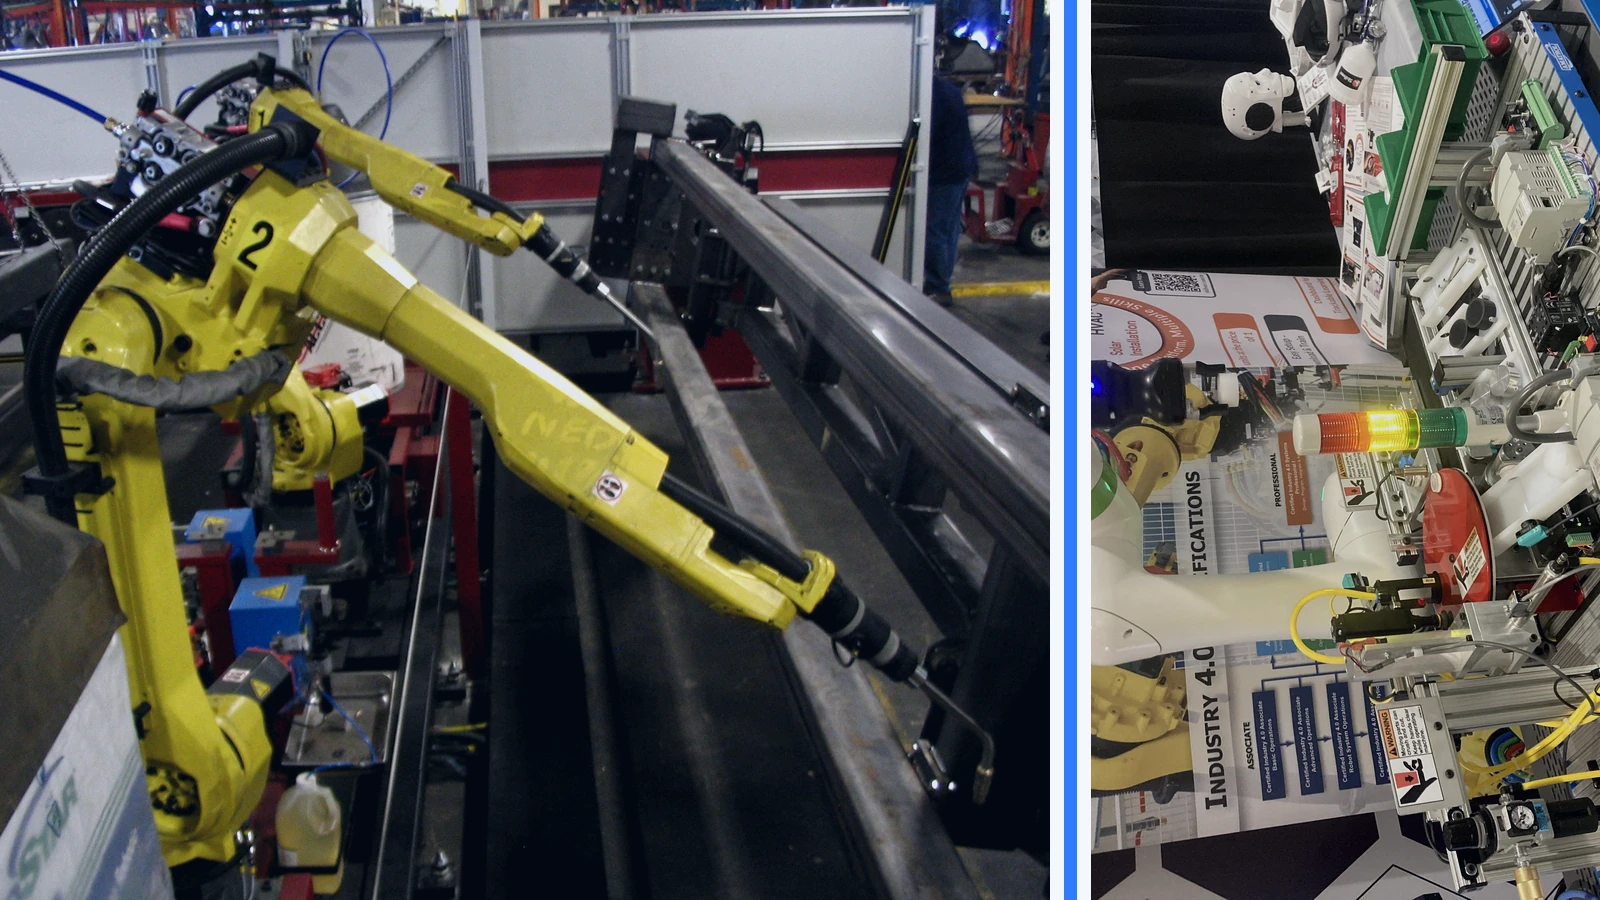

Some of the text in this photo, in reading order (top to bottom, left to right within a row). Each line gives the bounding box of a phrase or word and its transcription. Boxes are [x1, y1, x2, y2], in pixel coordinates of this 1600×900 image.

[237, 220, 274, 272] 2
[1102, 296, 1142, 310] Skills
[1306, 283, 1322, 304] Dashboard
[1325, 294, 1342, 314] Trackable
[1091, 312, 1104, 336] HVAC
[1144, 309, 1184, 338] Multiple
[1109, 341, 1123, 356] Solar
[1126, 320, 1143, 356] Installation
[1283, 338, 1295, 350] Setup
[1296, 336, 1309, 347] Train
[1290, 351, 1302, 360] Easy
[1336, 453, 1345, 472] WARNIN
[1270, 453, 1281, 507] PROFESSIONAL
[1292, 463, 1300, 494] Professional
[1184, 471, 1228, 810] INDUSTRY 4.0 FICATIONS
[1257, 700, 1265, 730] Associate
[1331, 692, 1339, 721] Associate
[1267, 718, 1276, 752] Operations
[1340, 696, 1354, 773] Robot System Operations
[1382, 712, 1394, 748] WARNING
[1410, 713, 1420, 738] operating
[1243, 722, 1255, 770] ASSOCIATE
[1300, 736, 1308, 760] Industry
[1304, 708, 1317, 772] Advanced Operations
[1336, 732, 1345, 756] Industry
[1373, 727, 1382, 751] Industry
[1398, 736, 1406, 756] Moving
[1262, 741, 1270, 766] Industry
[1376, 752, 1385, 778] Certified
[1264, 767, 1272, 793] Certified
[1302, 762, 1310, 788] Certified
[1339, 757, 1348, 782] Certified
